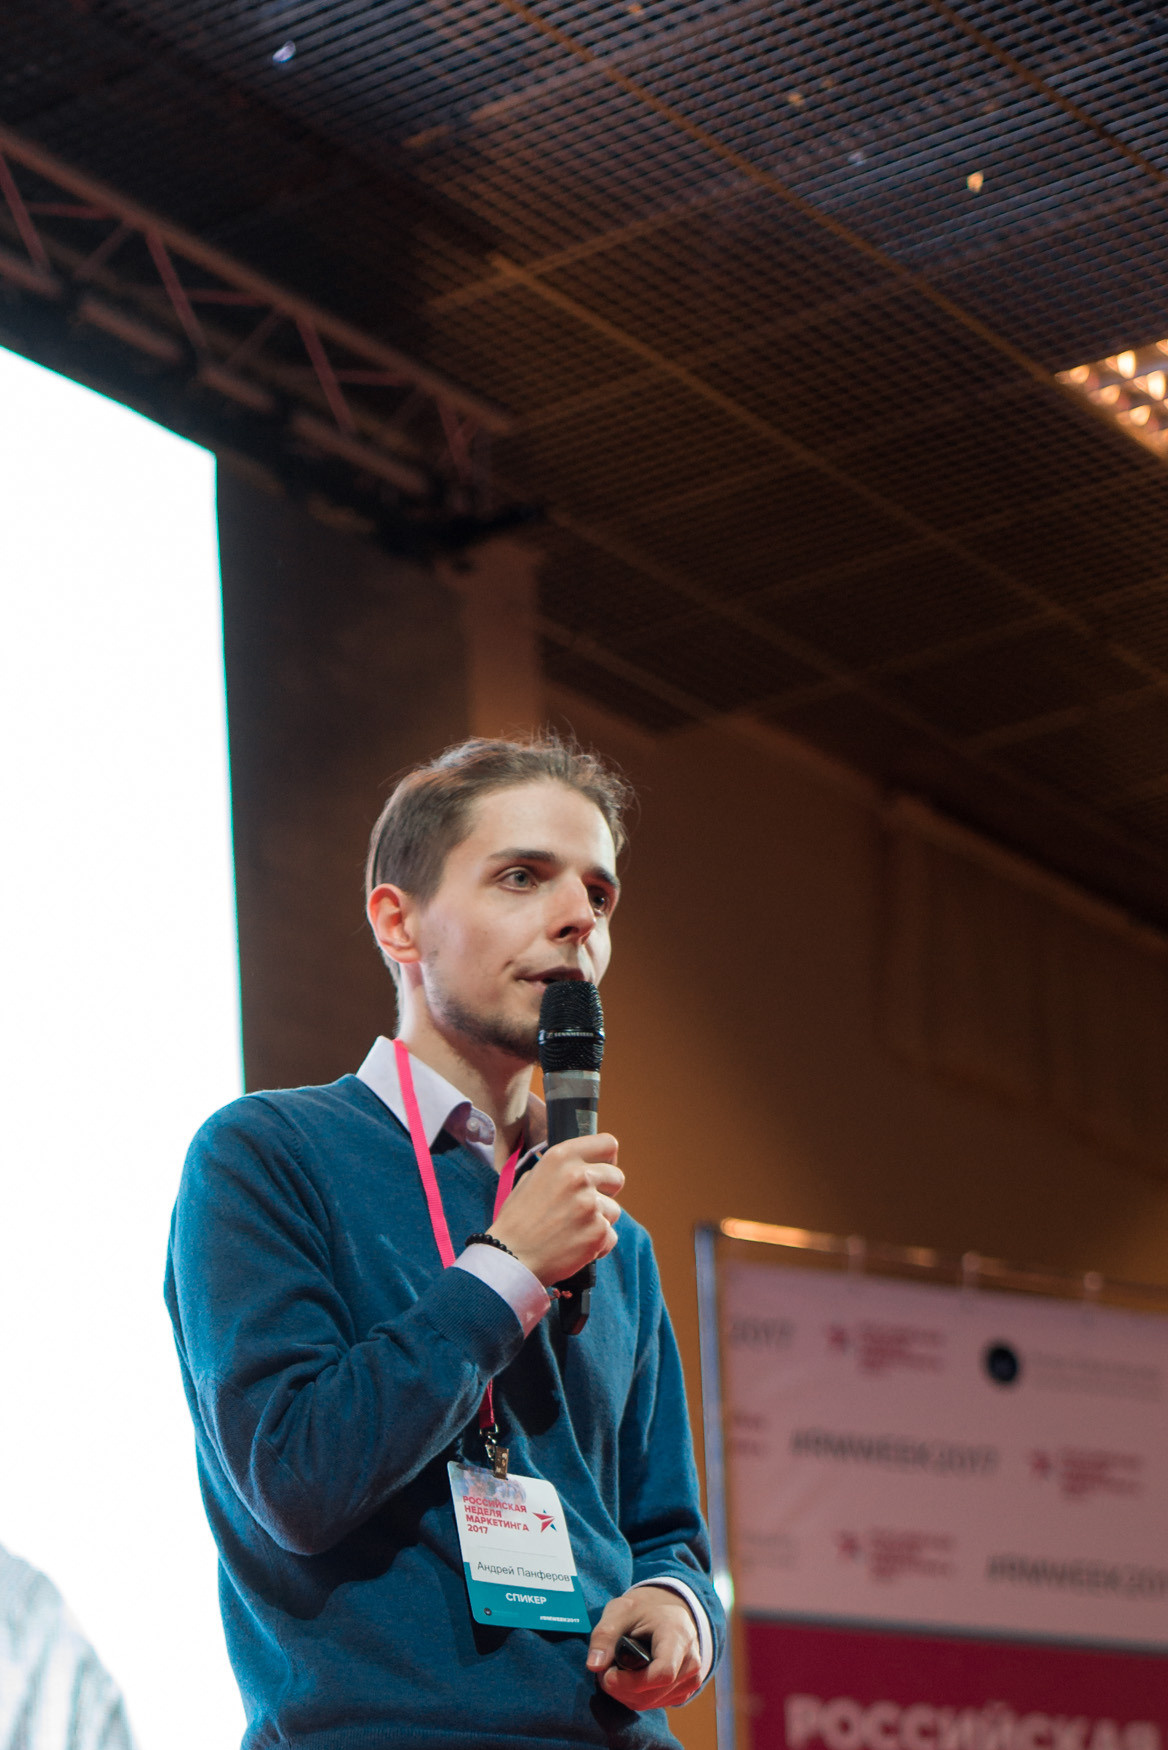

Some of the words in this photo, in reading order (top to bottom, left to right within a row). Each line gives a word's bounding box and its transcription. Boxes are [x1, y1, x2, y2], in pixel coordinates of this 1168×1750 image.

[462, 1495, 527, 1513] РОССИЙСКАЯ
[464, 1505, 502, 1518] НЕДЕЛЯ
[465, 1514, 530, 1532] МАРКЕТИНГА
[467, 1523, 488, 1534] 2017
[477, 1561, 515, 1576] Андрей
[505, 1592, 548, 1605] СПИКЕР
